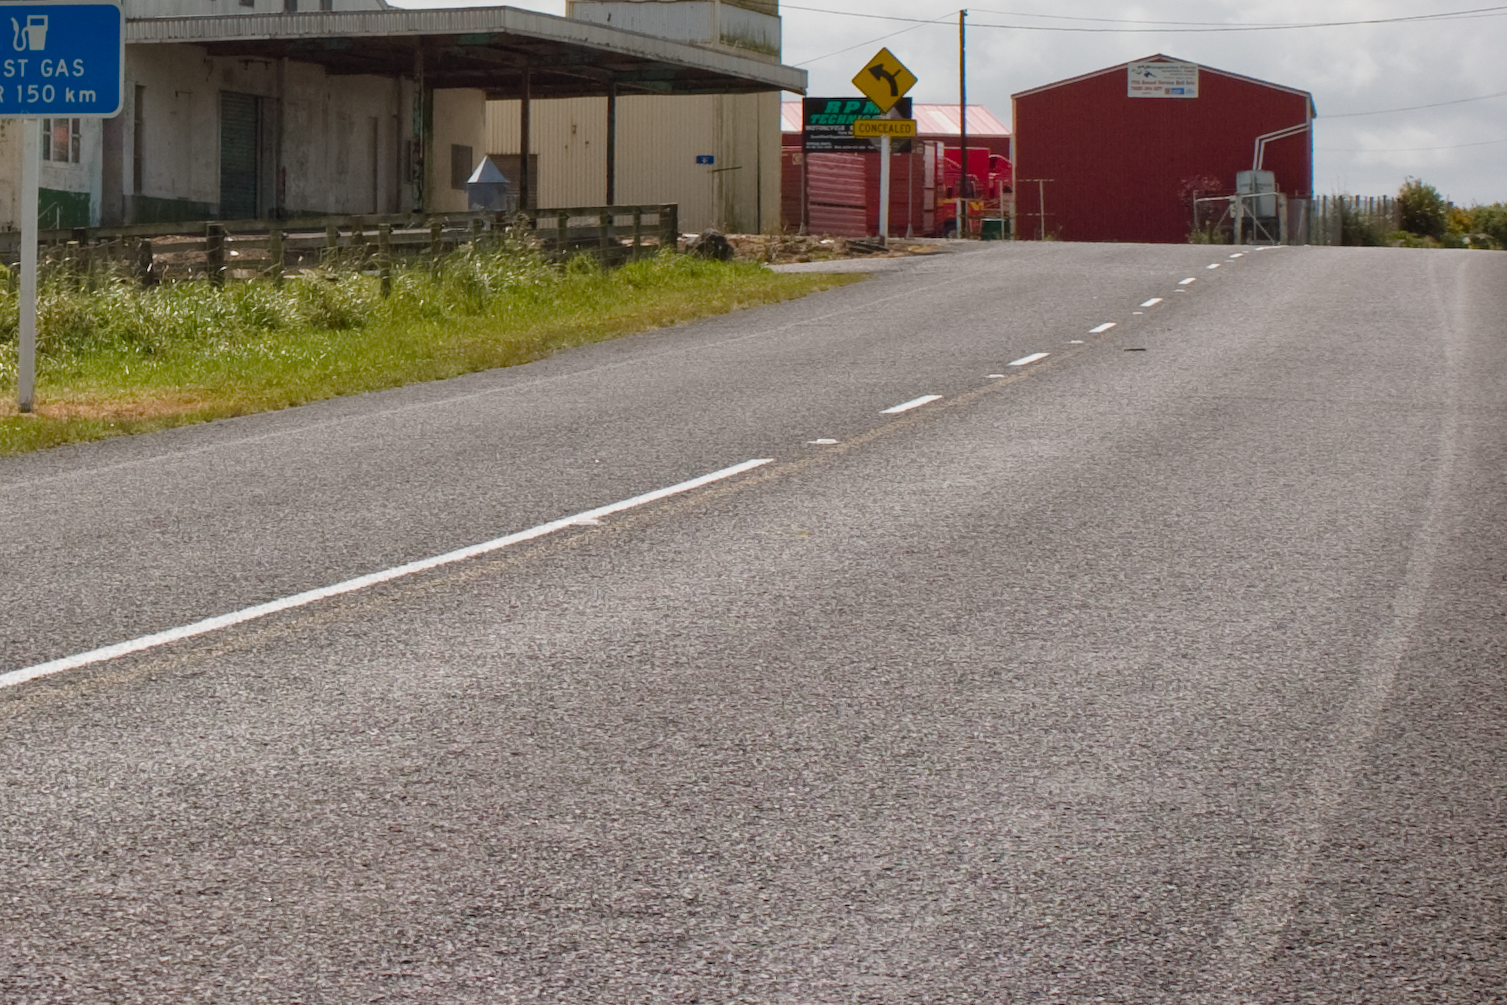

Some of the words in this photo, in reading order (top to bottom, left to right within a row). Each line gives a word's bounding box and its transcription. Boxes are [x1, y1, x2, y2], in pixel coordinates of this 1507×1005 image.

[40, 58, 85, 77] GAS
[17, 84, 55, 103] 150
[65, 87, 97, 103] km
[824, 101, 881, 114] RPM
[810, 114, 880, 124] TECHN
[858, 123, 912, 134] CONCEALED
